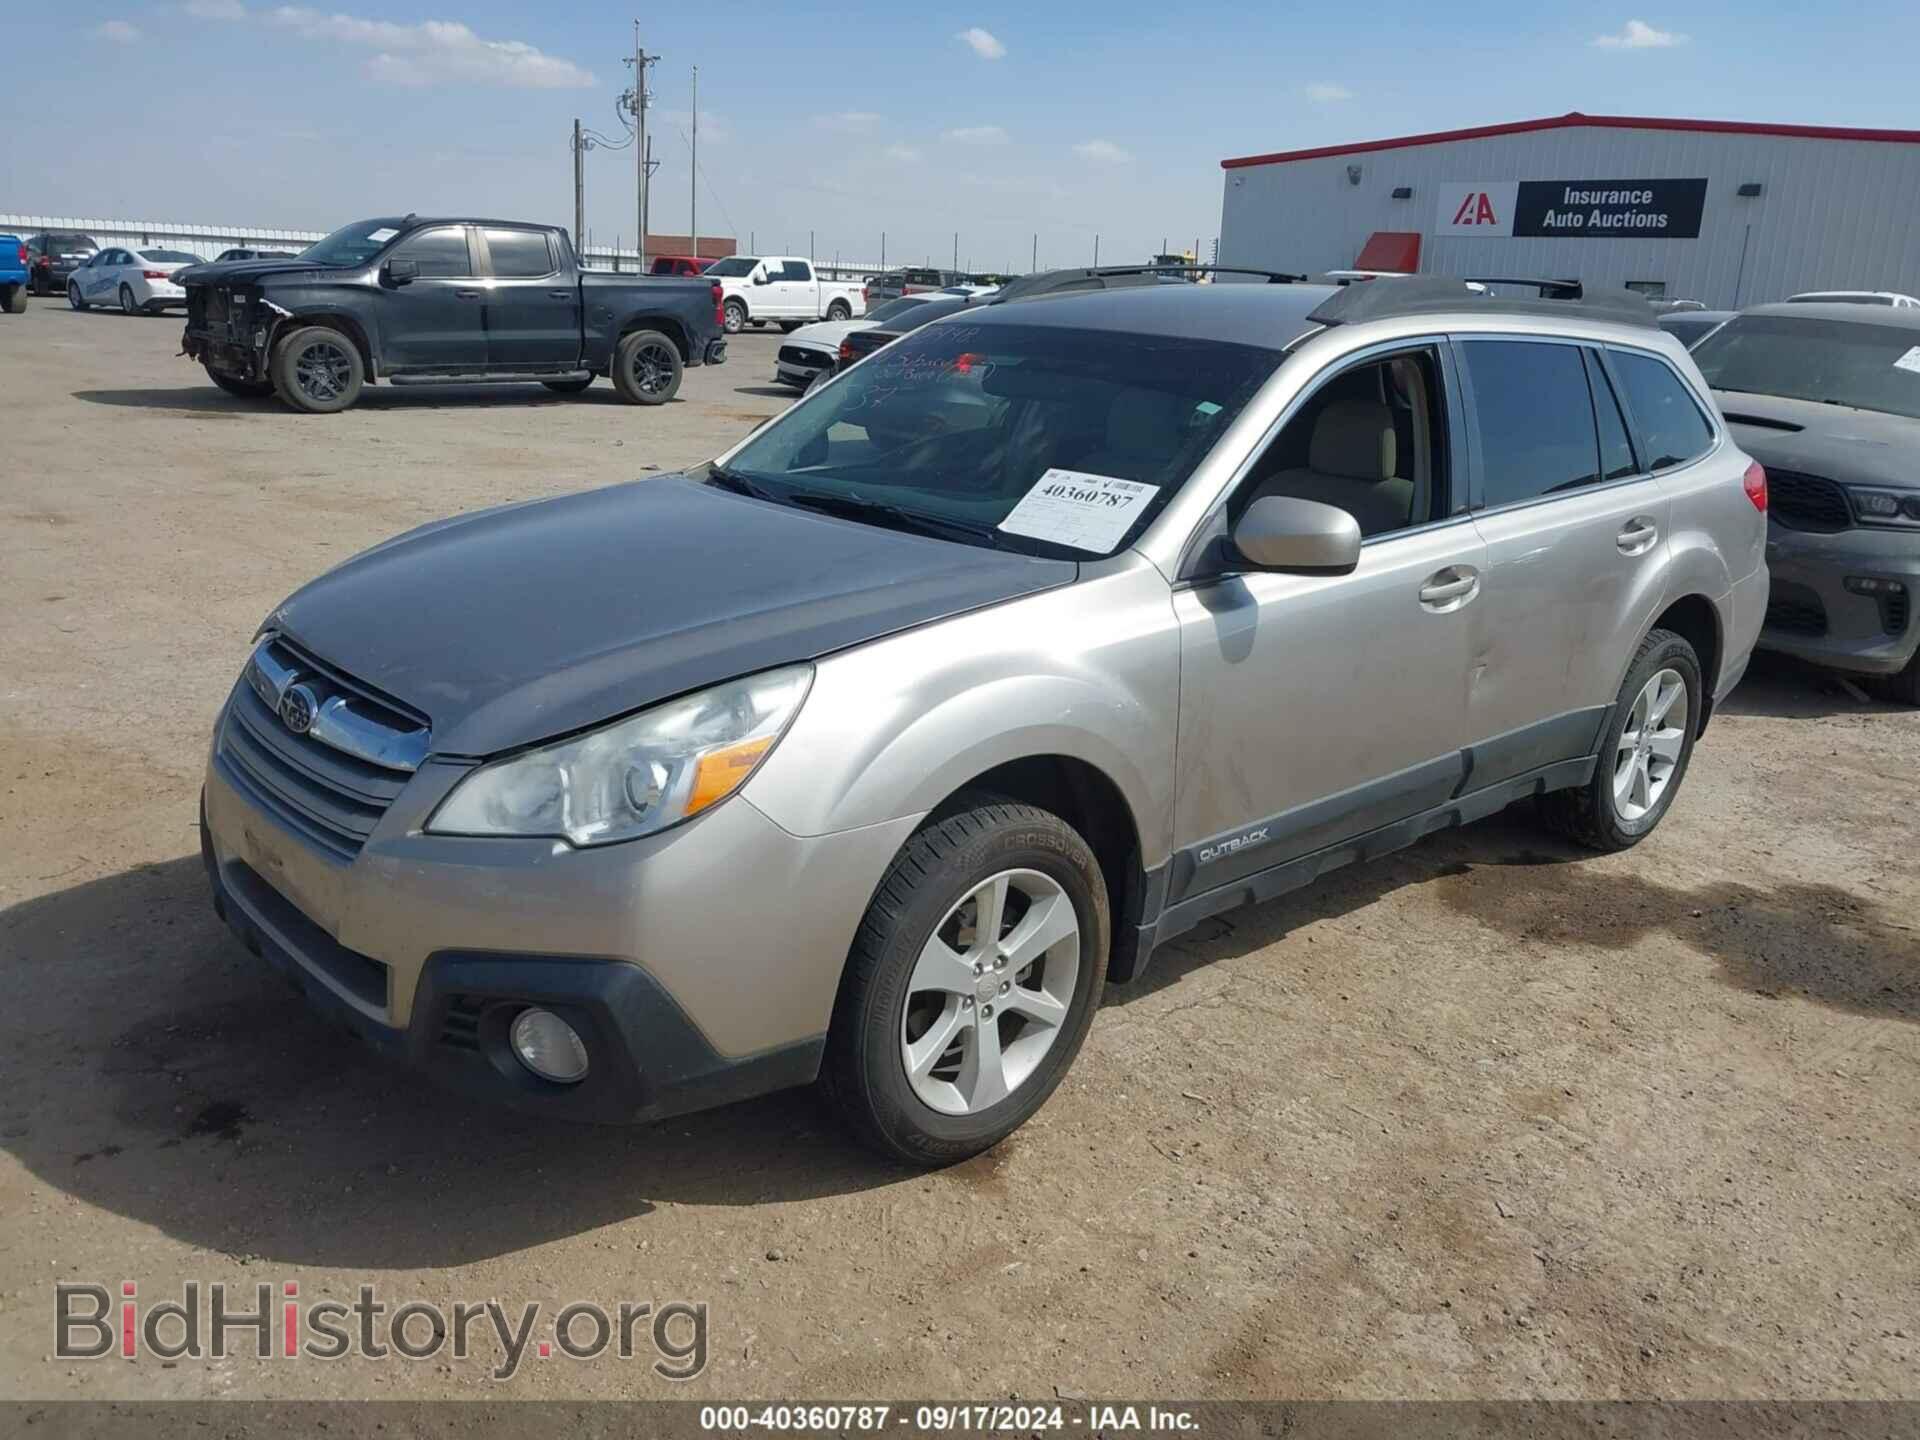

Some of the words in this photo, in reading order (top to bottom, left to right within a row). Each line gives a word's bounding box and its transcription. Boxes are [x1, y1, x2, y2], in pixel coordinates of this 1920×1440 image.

[1563, 187, 1653, 205] Insurance
[1543, 210, 1584, 228] Auto
[1588, 209, 1668, 228] Auctions
[1041, 484, 1134, 509] 40360787
[1199, 827, 1271, 861] OUTBACK
